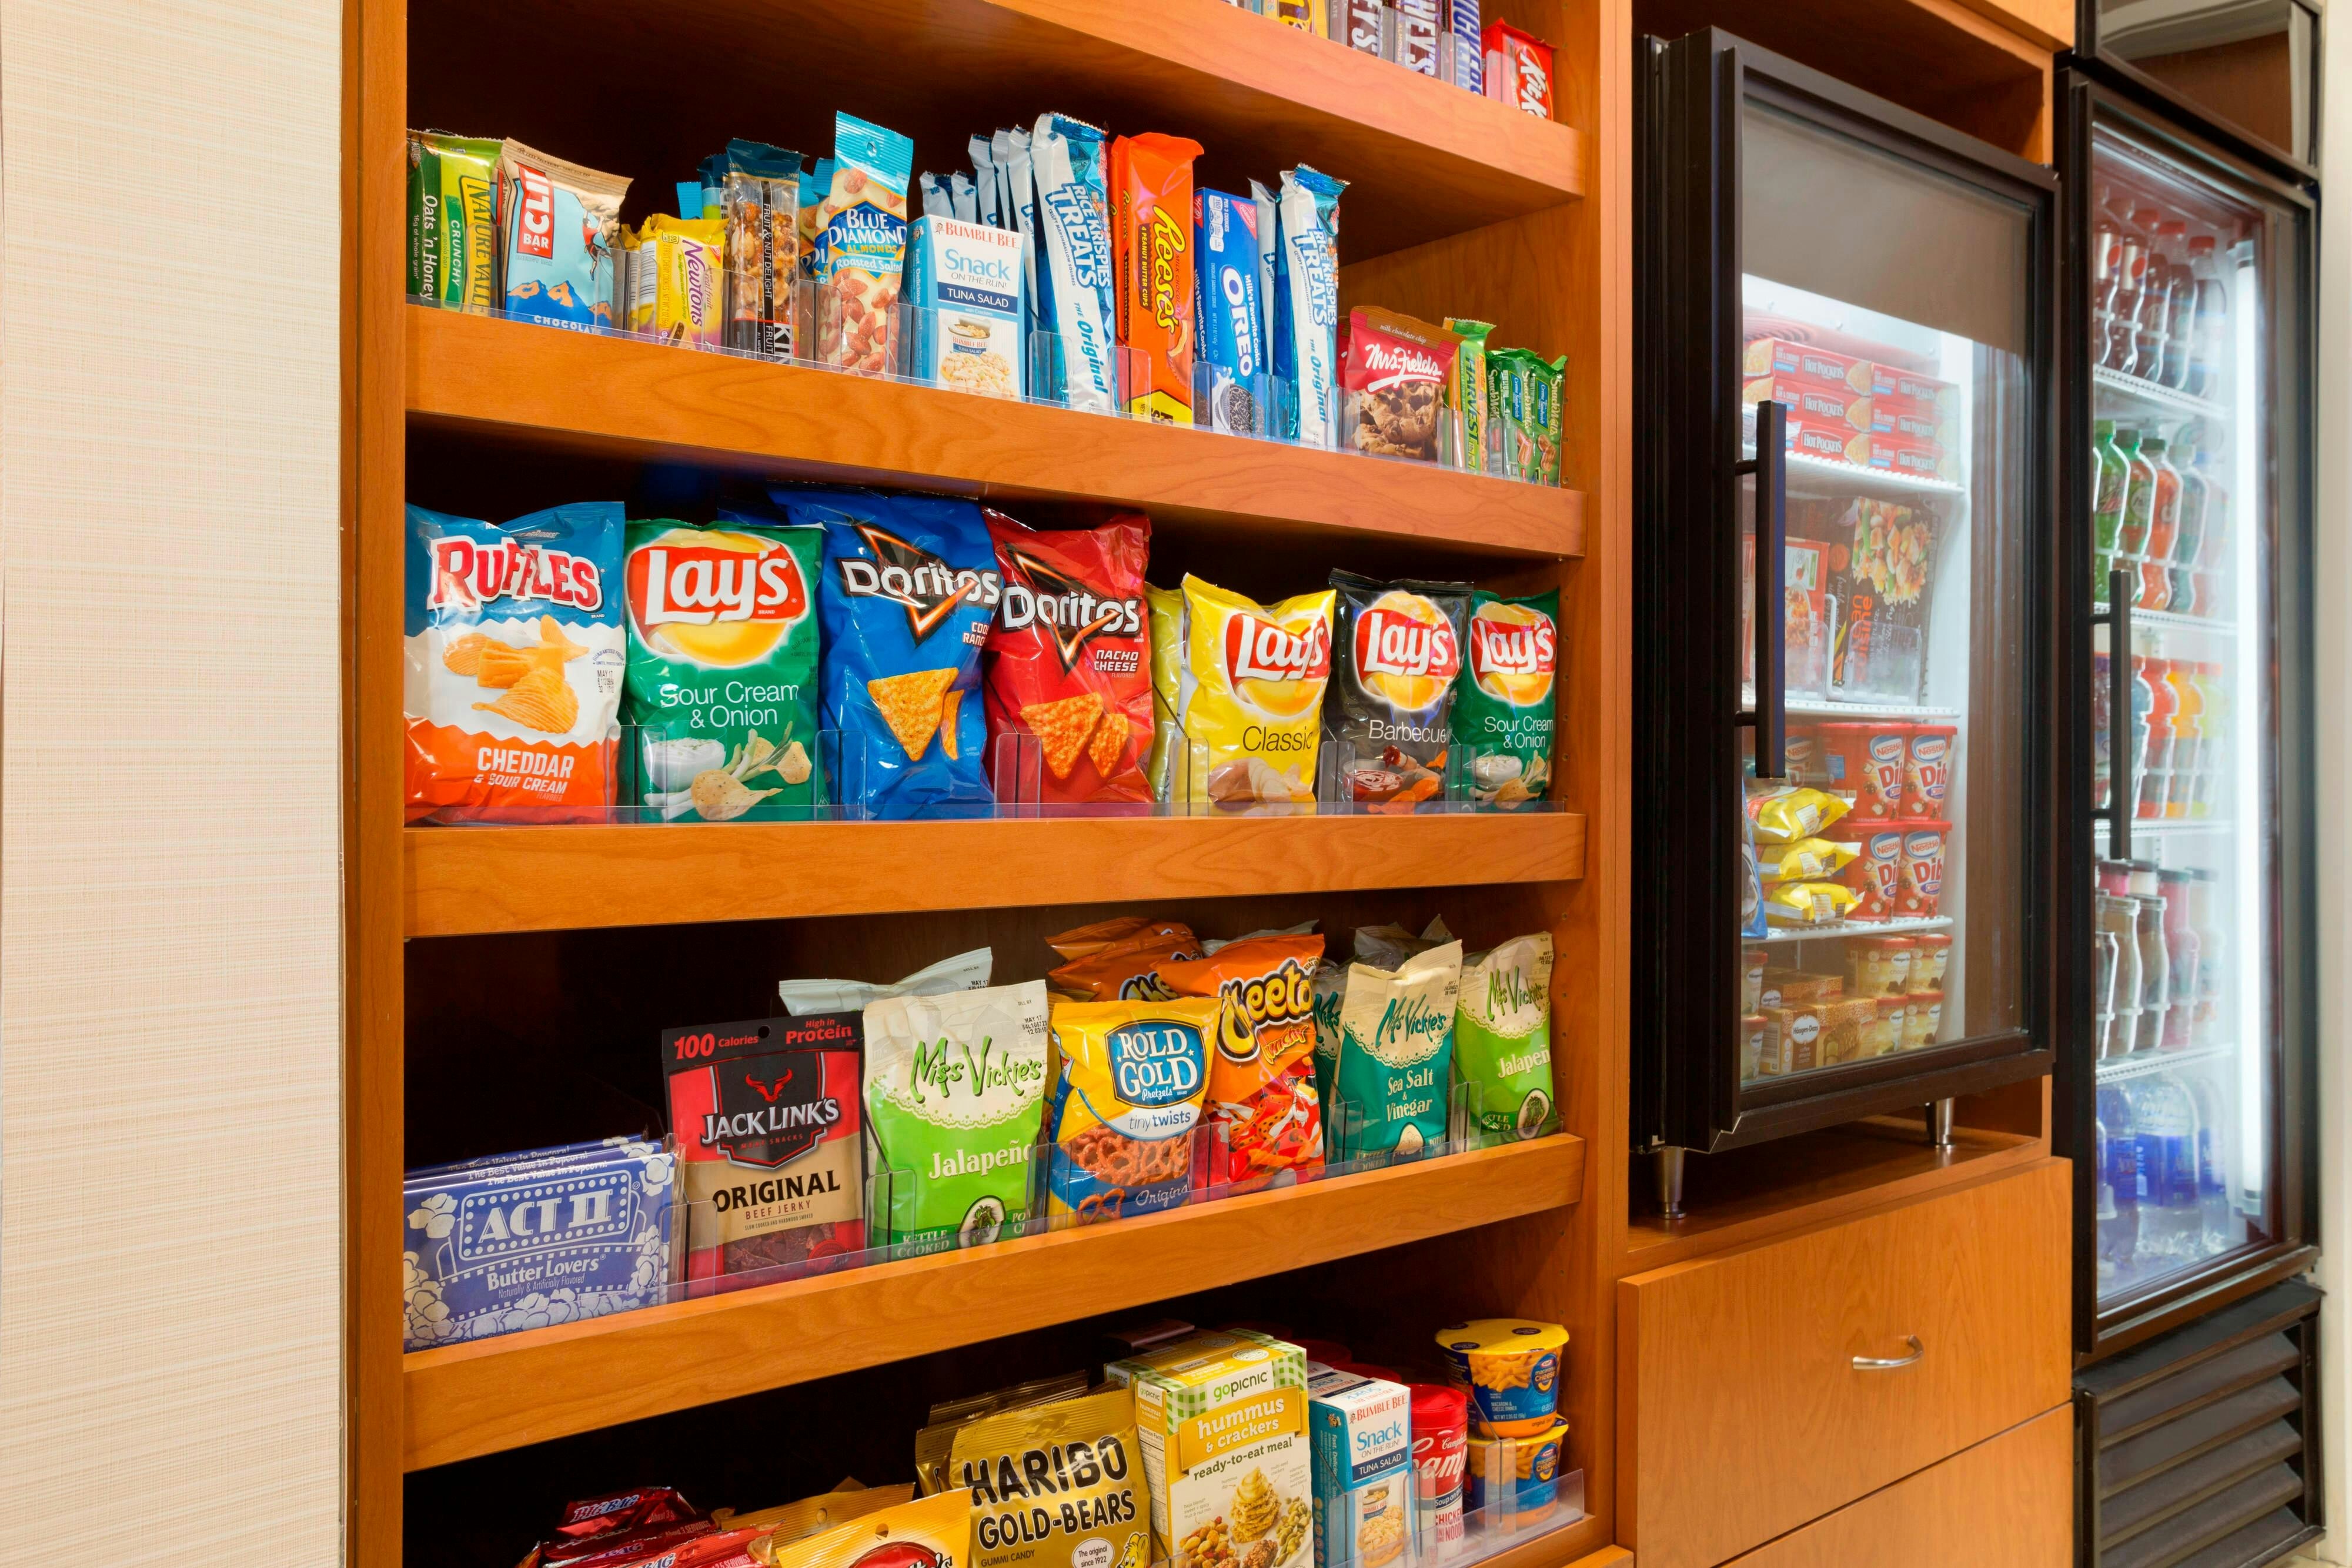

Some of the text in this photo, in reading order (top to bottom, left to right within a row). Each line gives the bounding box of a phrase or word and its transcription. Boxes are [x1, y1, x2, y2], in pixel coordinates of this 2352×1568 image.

[424, 195, 438, 230] Oats
[524, 168, 550, 233] CLIF
[467, 183, 491, 258] NATURE
[846, 208, 889, 230] BLUE
[523, 233, 549, 249] BAR
[828, 225, 907, 246] DIAMOND
[846, 244, 898, 254] ALMONDS
[946, 222, 1018, 249] BUMBLE BEE
[1045, 183, 1097, 289] TREATS
[1048, 209, 1058, 225] CRISPY
[1055, 225, 1071, 263] MARSHMALLOW
[1073, 185, 1111, 287] RICE KRISPIES
[450, 220, 460, 287] CRUNCHY
[836, 255, 877, 270] Roasted
[878, 258, 903, 273] Salted
[945, 248, 1011, 281] Snack
[420, 252, 437, 301] Honey
[682, 239, 705, 326] Newtons
[951, 272, 1007, 289] ON THE RUN!
[1152, 205, 1185, 335] Reese's
[1291, 230, 1327, 328] TREATS
[1314, 230, 1337, 326] RICE KRISPIES
[947, 287, 1009, 308] TUNA SALAD
[1244, 273, 1252, 302] Milk's
[1248, 302, 1257, 336] Favorite
[1222, 266, 1252, 377] OREO
[1379, 323, 1426, 345] milk chocolate chip
[953, 337, 974, 347] BUMBLE
[1074, 302, 1109, 395] THE Original
[1311, 355, 1331, 423] Original
[1465, 357, 1479, 444] HARVEST
[433, 541, 599, 607] RUFFLES
[645, 549, 789, 625] Lay's
[840, 559, 1001, 606] Doritos
[1002, 586, 1141, 633] Doritos
[1096, 649, 1139, 662] NACHO
[1235, 614, 1325, 681] Lay's
[1364, 611, 1450, 676] Lay's
[1476, 620, 1554, 675] Lay's
[1094, 659, 1138, 672] CHEESE
[659, 681, 800, 707] Sour Cream
[690, 705, 777, 728] & Onion
[1368, 719, 1446, 743] Barbecue
[1484, 716, 1553, 733] Sour Cream
[1242, 726, 1312, 753] Classic
[1503, 733, 1546, 748] & Onion
[477, 747, 574, 778] CHEDDAR
[1910, 839, 1939, 854] Nestlé
[1304, 962, 1313, 971] REAL
[1487, 965, 1544, 1022] Miss Vickie's
[806, 1018, 836, 1029] High in
[1217, 964, 1312, 1056] Cheeto
[1375, 994, 1446, 1048] Miss Vickie's
[674, 1033, 759, 1059] 100 Calories
[786, 1025, 852, 1045] Protein
[1120, 1028, 1188, 1060] ROLD
[910, 1035, 1043, 1104] Miss Vickie's
[1119, 1057, 1198, 1098] GOLD
[1388, 1068, 1434, 1096] Sea Salt
[1142, 1085, 1173, 1101] Pretzels
[701, 1097, 840, 1145] JACK LINK'S
[1130, 1110, 1191, 1132] tiny twists
[1387, 1098, 1432, 1122] Vinegar
[741, 1133, 803, 1149] MEAT SNACKS
[712, 1169, 840, 1213] ORIGINAL
[478, 1189, 613, 1244] ACT II
[745, 1199, 811, 1221] BEEF JERKY
[487, 1256, 599, 1292] Butter Lovers
[499, 1273, 584, 1299] Naturally & Artificially Flavored
[1140, 1387, 1160, 1402] gopicnic
[1213, 1371, 1268, 1402] gopicnic
[1198, 1397, 1285, 1440] hummus
[1357, 1394, 1406, 1421] BUMBLE BEE
[1205, 1418, 1279, 1453] & crackers
[1357, 1420, 1402, 1451] Snack
[1193, 1443, 1265, 1482] ready-to-eat
[1267, 1437, 1292, 1454] meal
[1359, 1453, 1401, 1475] TUNA SALAD
[1361, 1449, 1372, 1458] ON
[1373, 1445, 1384, 1454] THE
[963, 1435, 1128, 1507] HARIBO
[1436, 1497, 1449, 1506] Soup
[978, 1489, 1136, 1550] GOLD-BEARS
[981, 1549, 1035, 1567] GUMMI CANDY
[1078, 1545, 1107, 1558] The original
[1081, 1556, 1107, 1568] since 1922
